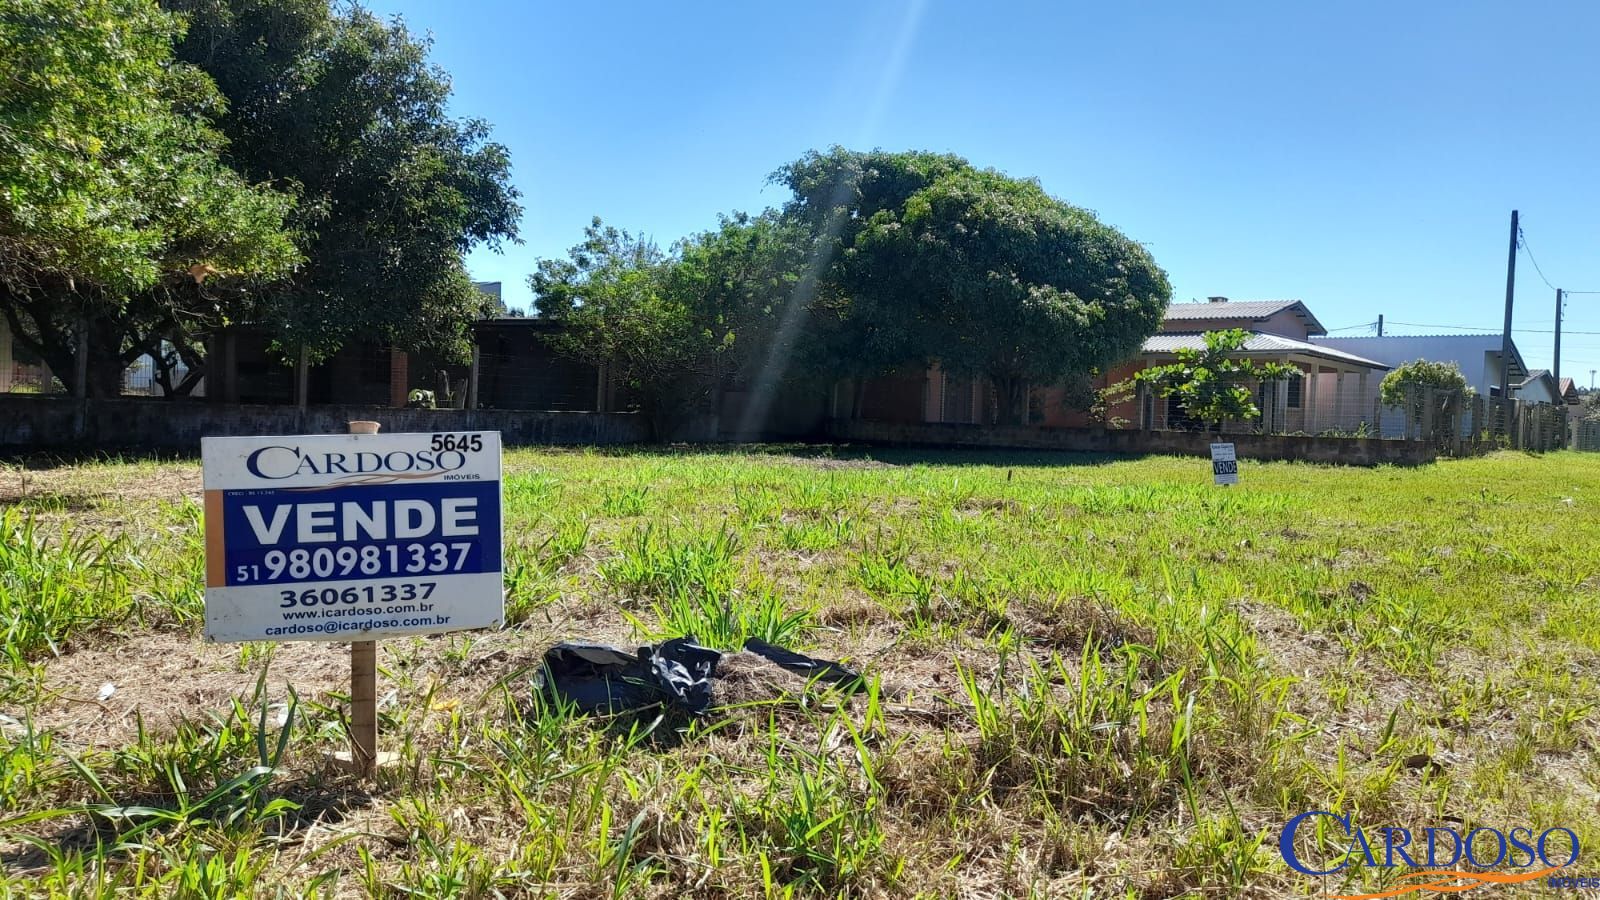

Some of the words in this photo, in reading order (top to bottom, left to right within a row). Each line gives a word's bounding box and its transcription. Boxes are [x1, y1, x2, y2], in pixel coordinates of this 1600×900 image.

[431, 434, 483, 452] 5645
[246, 446, 466, 480] CARDOSO
[1214, 462, 1237, 473] VENDE
[443, 473, 481, 481] IMÓVEIS
[242, 497, 480, 545] VENDE
[236, 565, 260, 582] 51
[264, 542, 472, 580] 980981337
[279, 582, 437, 608] 36061337
[282, 602, 434, 620] www.icardoso.com.br
[265, 615, 451, 636] cardoso@icardoso.com.br
